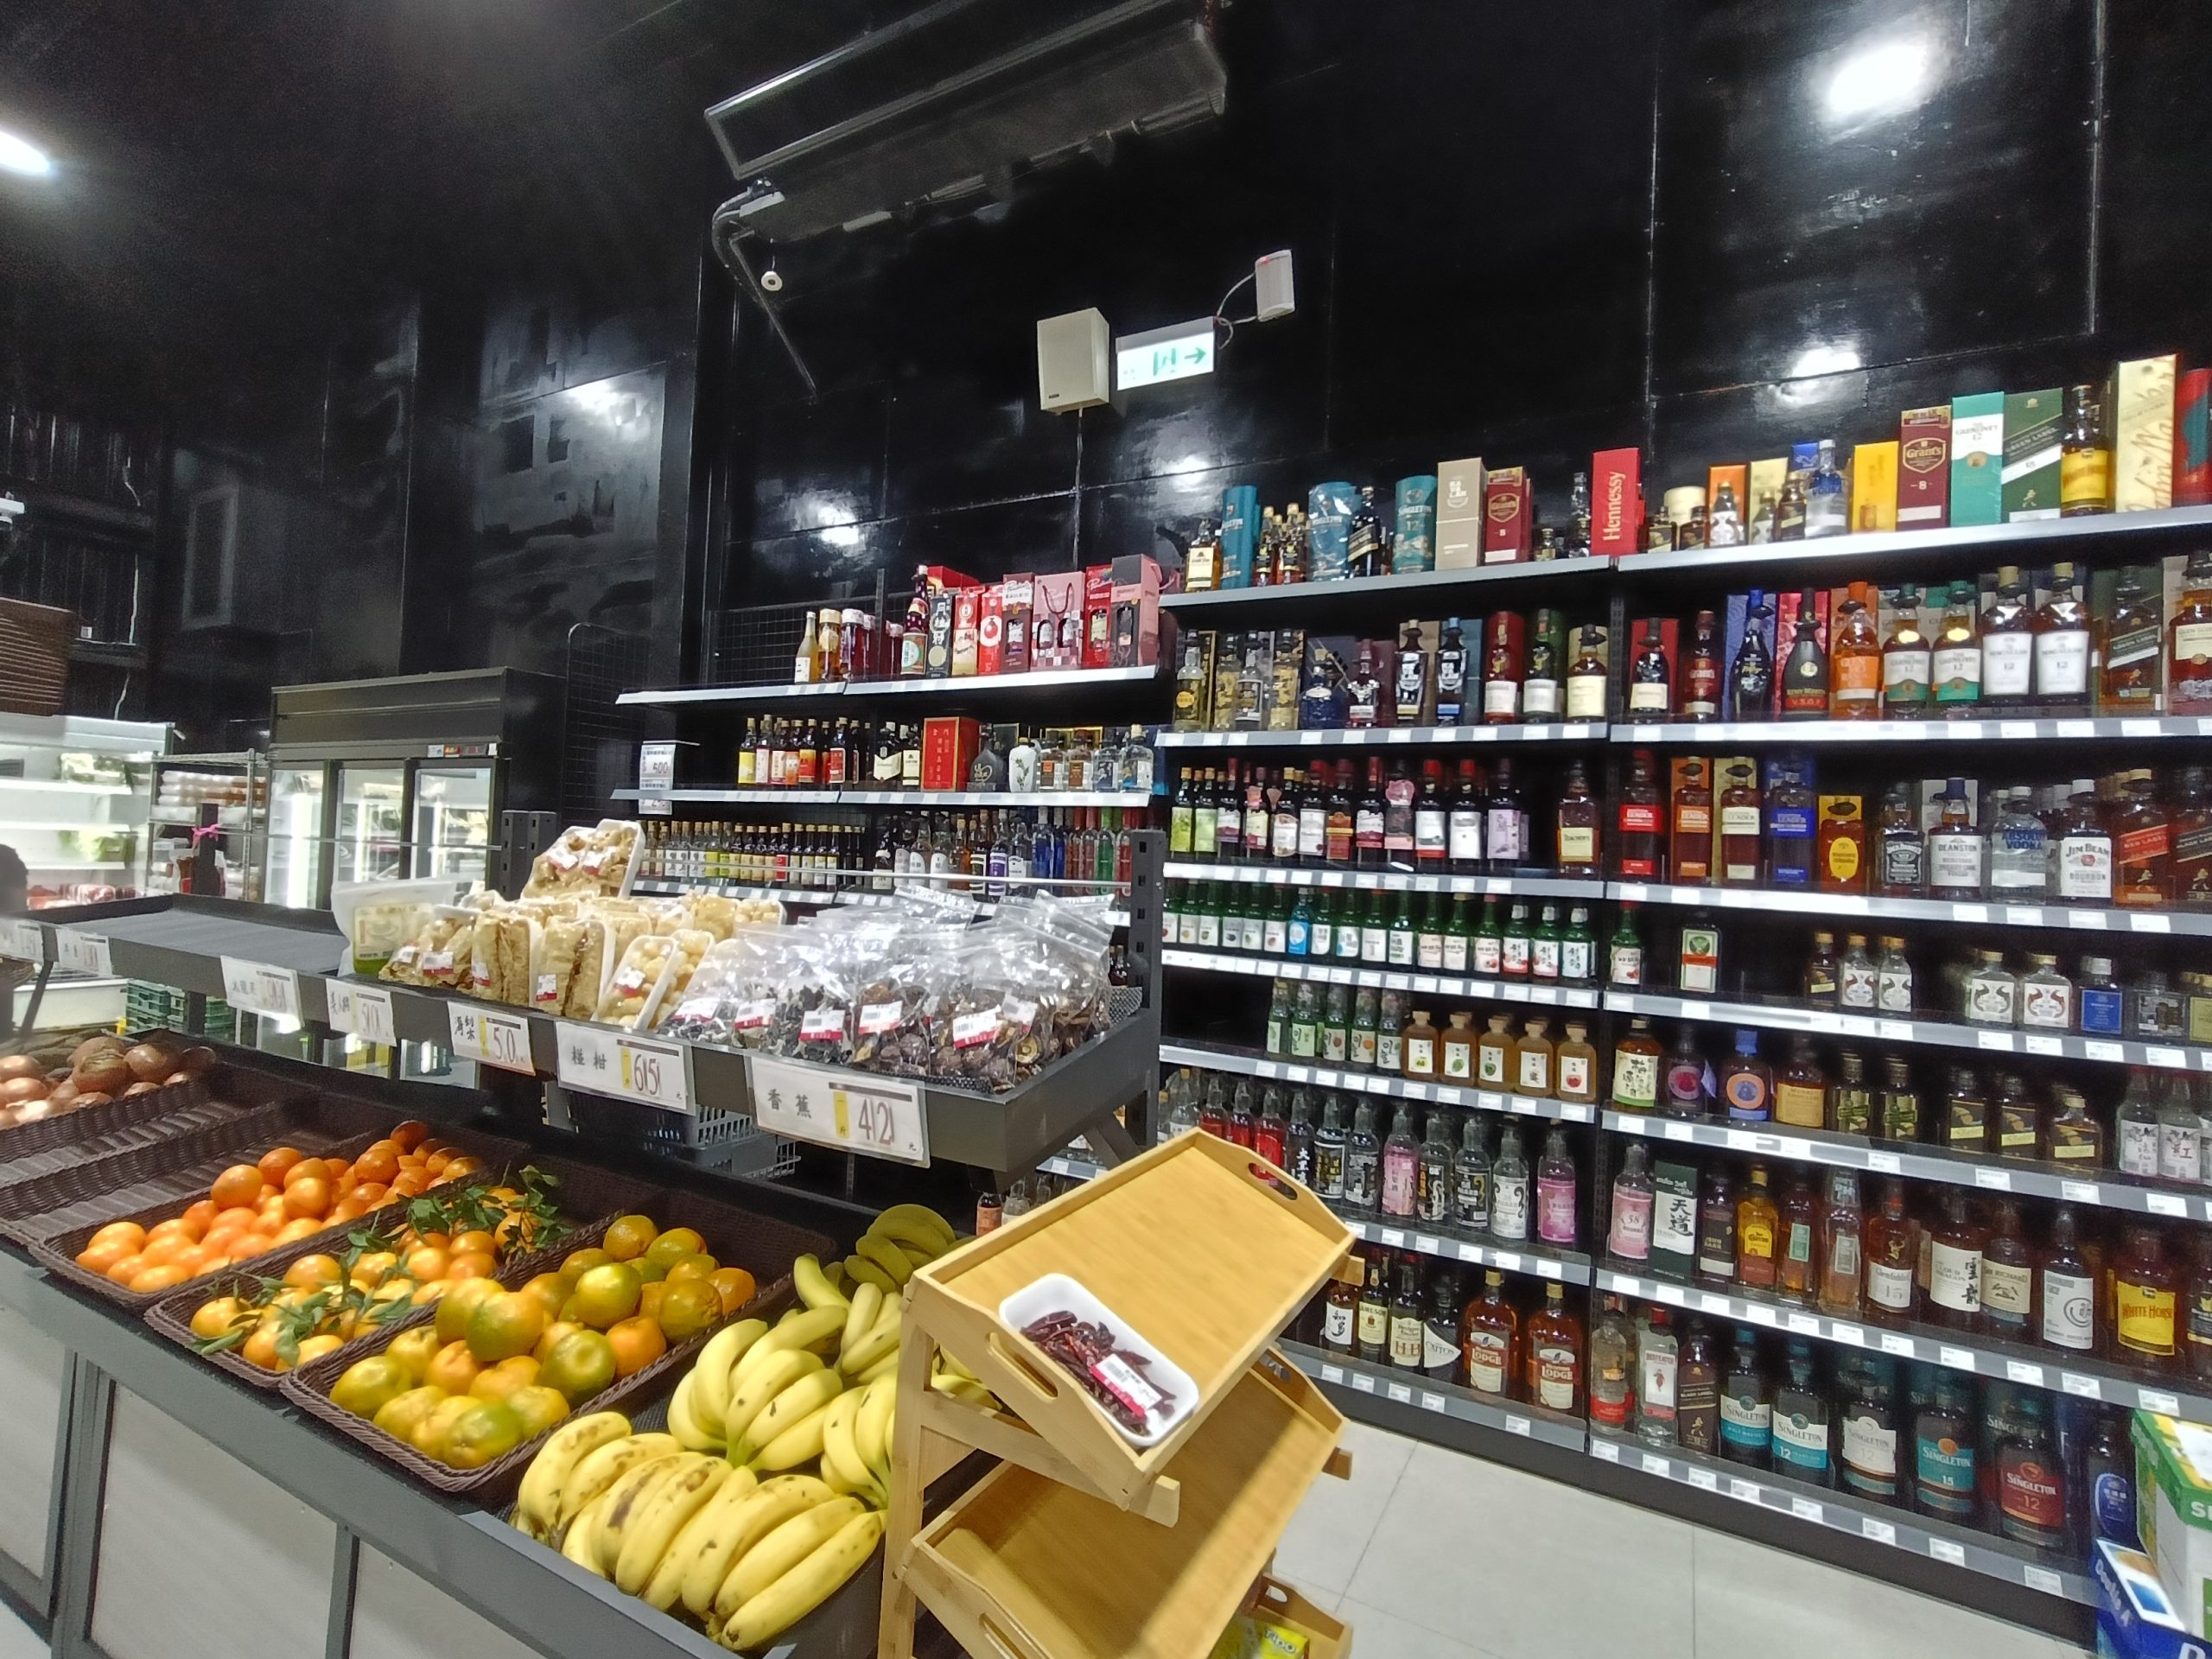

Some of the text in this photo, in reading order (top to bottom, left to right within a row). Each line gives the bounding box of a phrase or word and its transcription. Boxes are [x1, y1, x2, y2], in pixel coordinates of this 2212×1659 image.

[1906, 446, 1942, 458] Grant's
[1603, 470, 1626, 542] Hennessy
[2066, 846, 2084, 858] JIM
[493, 1027, 516, 1064] 50
[767, 1088, 812, 1120] 香蕉
[1669, 1198, 1694, 1236] 天道
[1359, 1306, 1387, 1316] AMESON
[1471, 1347, 1502, 1365] LODGE
[1541, 1365, 1573, 1381] LODGE
[1726, 1404, 1768, 1421] SINGLETON
[1777, 1421, 1822, 1442] SINGLETON
[1780, 1446, 1791, 1460] 12
[1923, 1446, 1971, 1467] SINGLETON
[1942, 1474, 1954, 1486] 15
[2006, 1471, 2057, 1496] SINGLETON
[2024, 1495, 2040, 1510] 12
